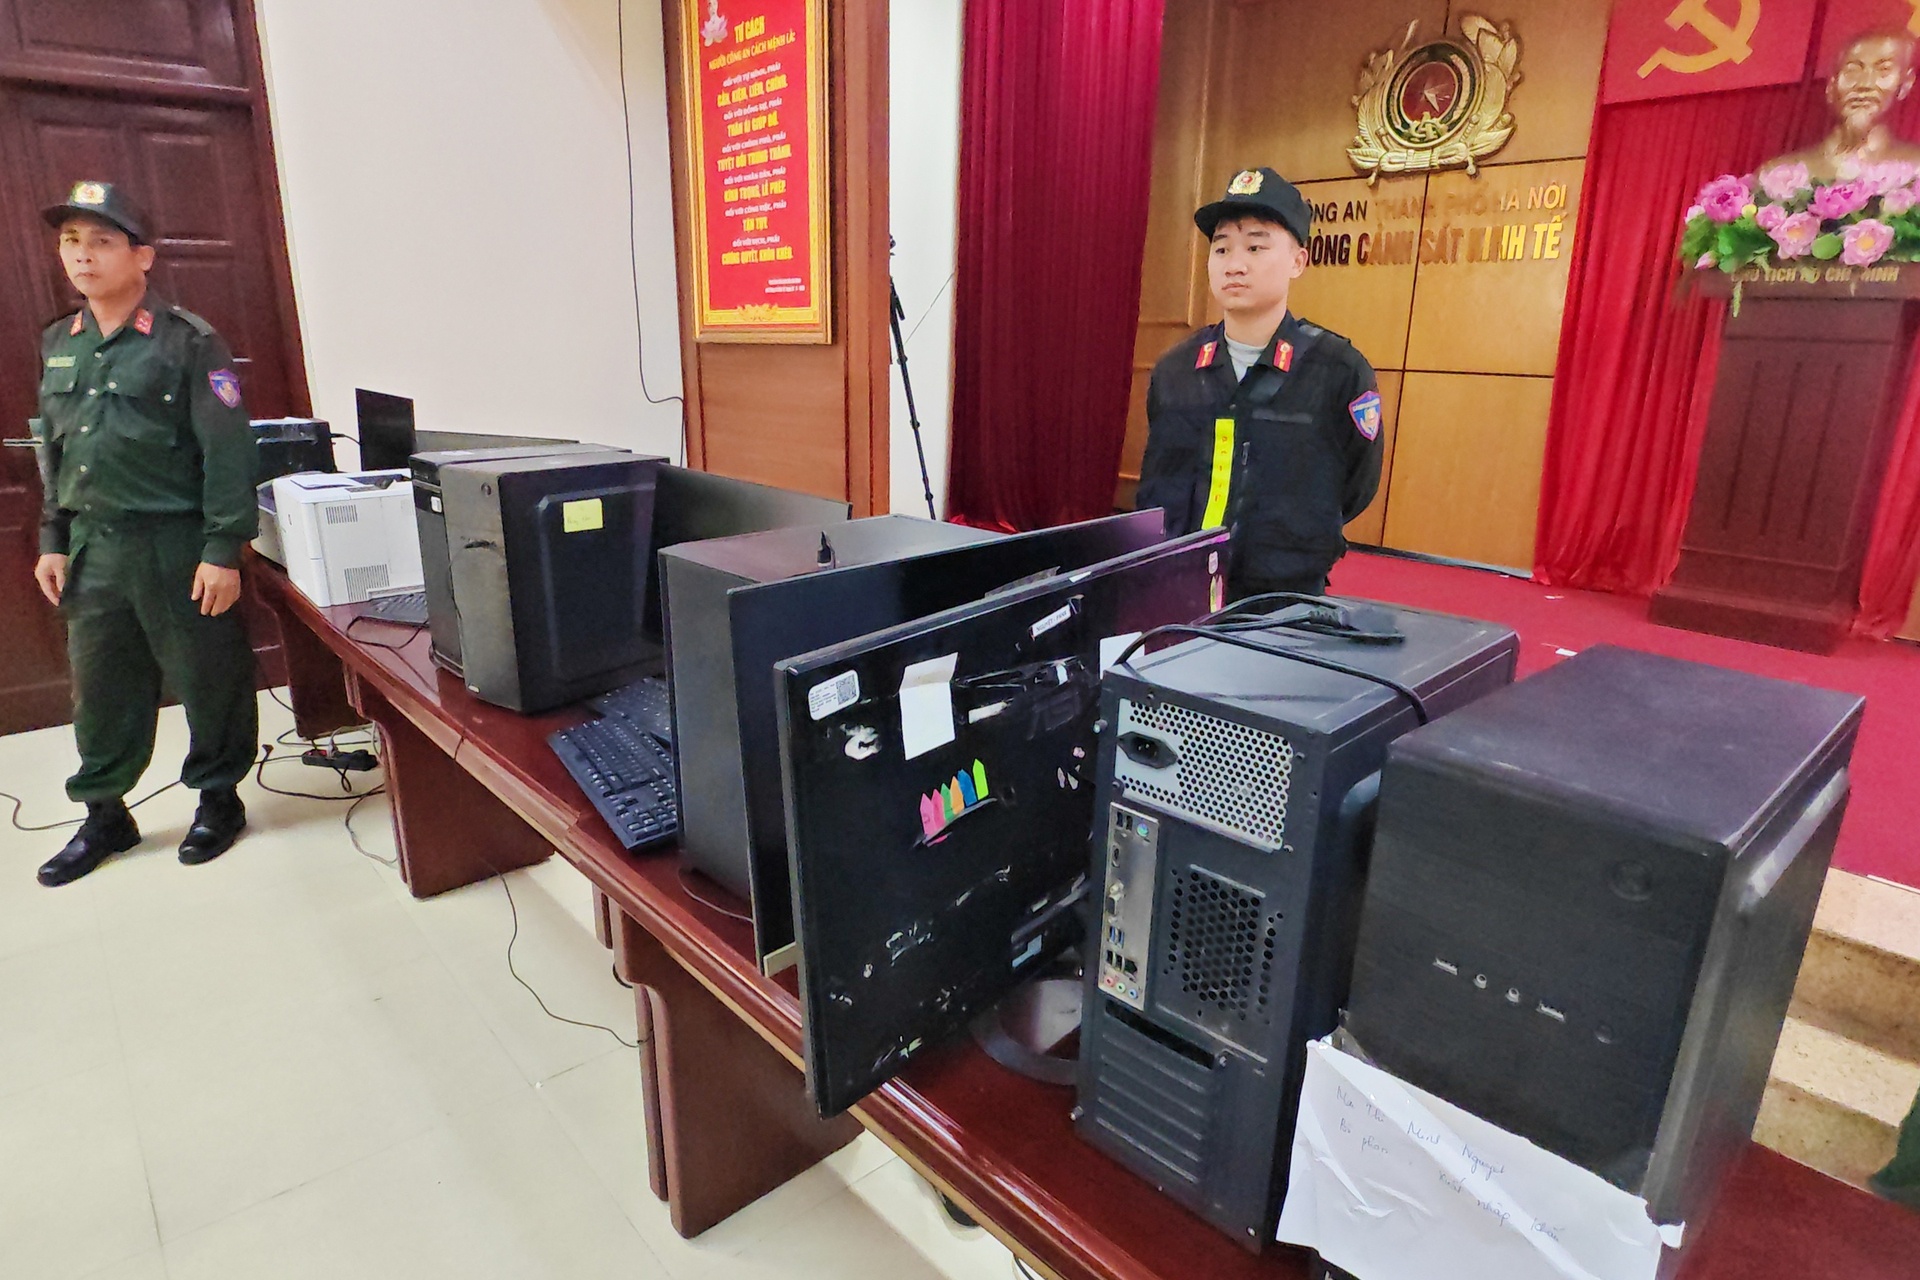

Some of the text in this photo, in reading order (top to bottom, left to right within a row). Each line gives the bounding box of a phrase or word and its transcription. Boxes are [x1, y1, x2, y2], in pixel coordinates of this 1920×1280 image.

[745, 16, 765, 40] CÁCH
[751, 41, 766, 57] CÁCH
[1304, 198, 1338, 223] ÔNG
[1342, 200, 1368, 222] AN
[1527, 181, 1567, 216] NỘI
[1532, 211, 1569, 260] TẾ
